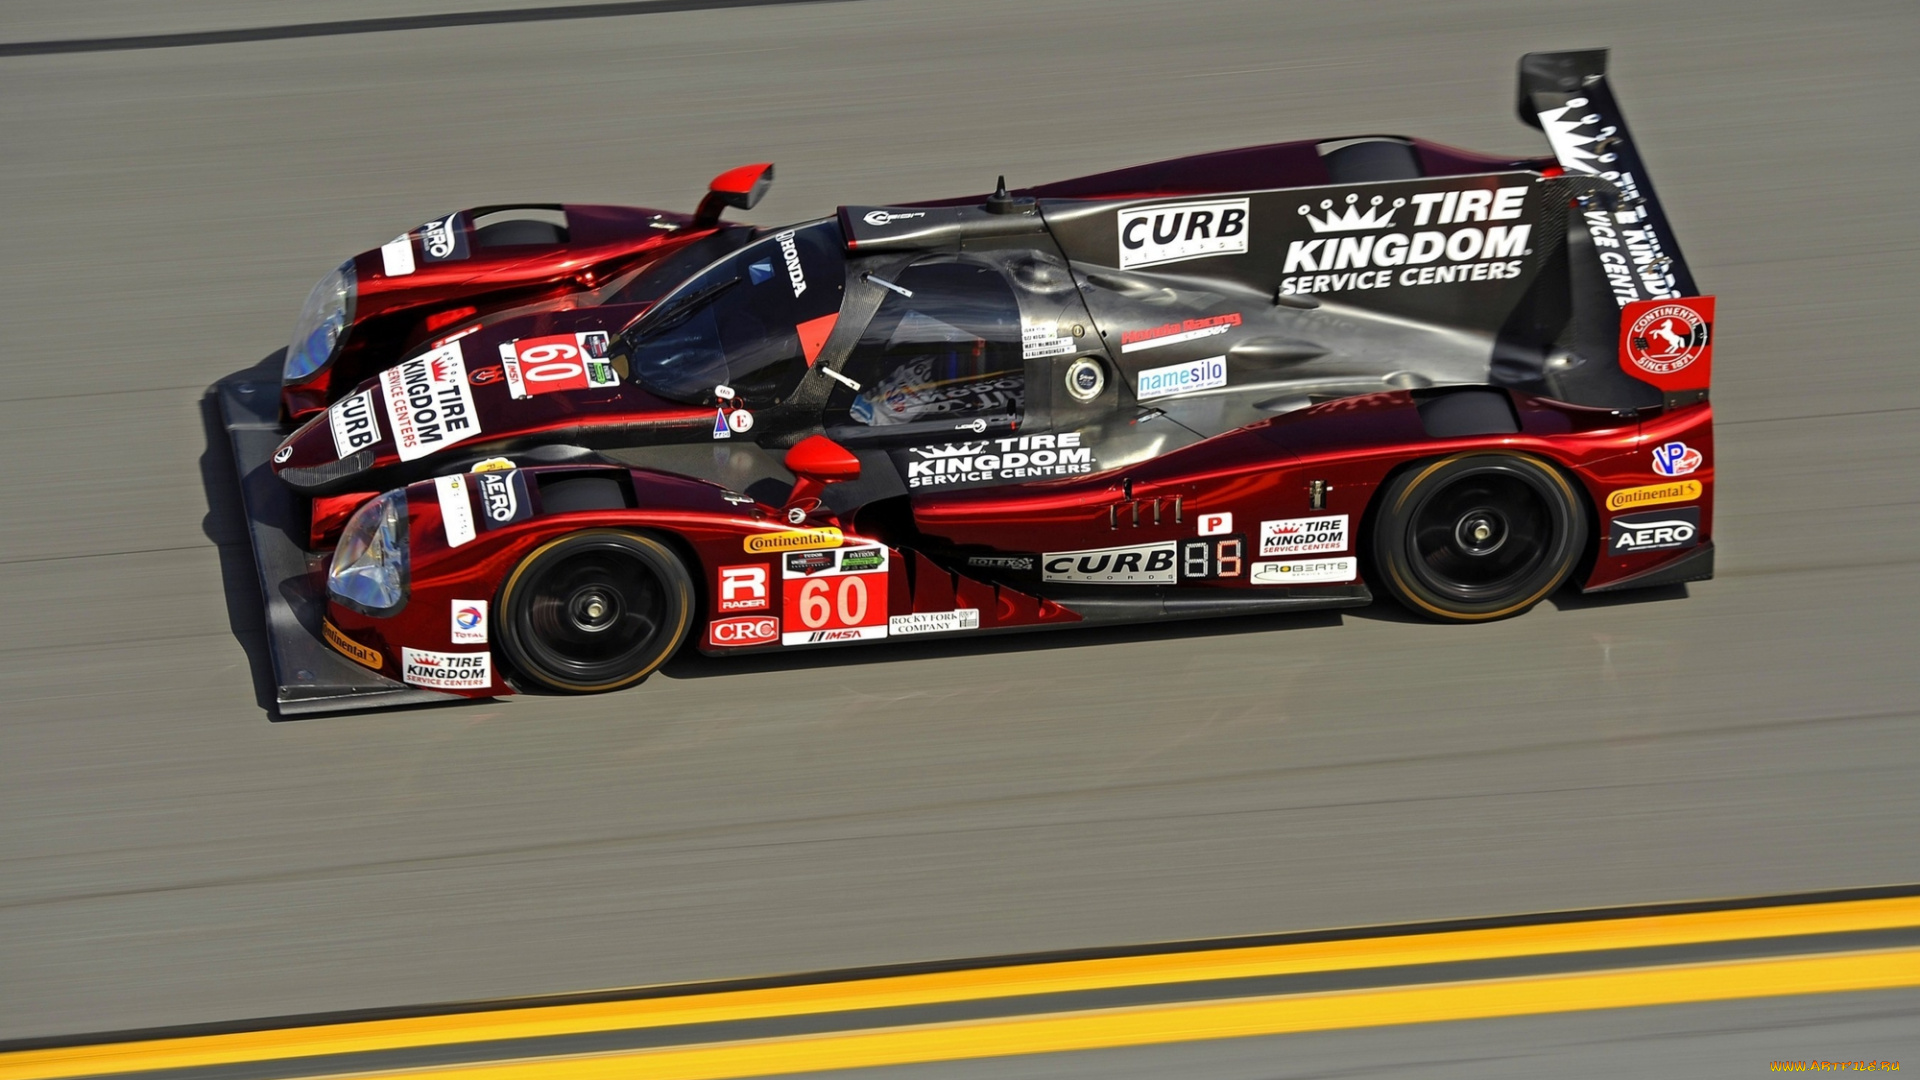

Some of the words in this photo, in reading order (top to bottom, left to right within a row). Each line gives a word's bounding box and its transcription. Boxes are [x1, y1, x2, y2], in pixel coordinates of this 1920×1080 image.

[1410, 186, 1529, 227] TIRE
[424, 221, 449, 257] AERO
[1122, 209, 1246, 250] CURB
[1282, 224, 1532, 274] KINGDOM
[779, 240, 807, 298] HONDA
[1279, 272, 1391, 296] SERVICE
[1399, 261, 1522, 286] CENTERS
[1600, 252, 1640, 309] CENTE
[1121, 323, 1180, 345] Honda
[1183, 312, 1243, 331] Racing
[1634, 307, 1701, 333] CONTINENTAL
[521, 344, 582, 382] 60
[1638, 356, 1669, 371] SINCE
[1671, 353, 1694, 369] 1871
[388, 365, 404, 398] SERVICE
[1140, 361, 1222, 391] namesilo
[402, 359, 443, 444] KINGDOM
[438, 385, 470, 432] TIRE
[342, 396, 373, 448] CURB
[394, 399, 418, 448] CENTERS
[737, 415, 747, 427] E
[995, 432, 1081, 452] TIRE
[908, 448, 1092, 477] KINGDOM
[1655, 443, 1685, 474] VP
[909, 471, 993, 488] SERVICE
[1000, 464, 1091, 478] CENTERS
[484, 474, 511, 521] AERO
[1612, 485, 1684, 508] Continental
[1207, 517, 1222, 532] P
[1306, 520, 1341, 532] TIRE
[1615, 526, 1694, 548] AERO
[750, 532, 826, 551] Continental
[1263, 545, 1299, 553] SERVICE
[1302, 542, 1341, 551] CENTERS
[1265, 532, 1343, 546] KINGDOM
[1045, 549, 1175, 574] CURB
[1264, 562, 1348, 573] ROBERTS
[723, 567, 766, 600] R
[723, 600, 766, 609] RACER
[800, 576, 868, 629] 60
[714, 620, 775, 641] CRC
[891, 614, 928, 625] ROCKY
[930, 613, 957, 622] FORK
[898, 622, 951, 633] COMPANY
[324, 624, 368, 660] ontinental
[825, 631, 862, 641] IMSA
[407, 664, 485, 679] KINGDOM
[446, 656, 483, 667] TIRE
[407, 675, 441, 685] SERVICE
